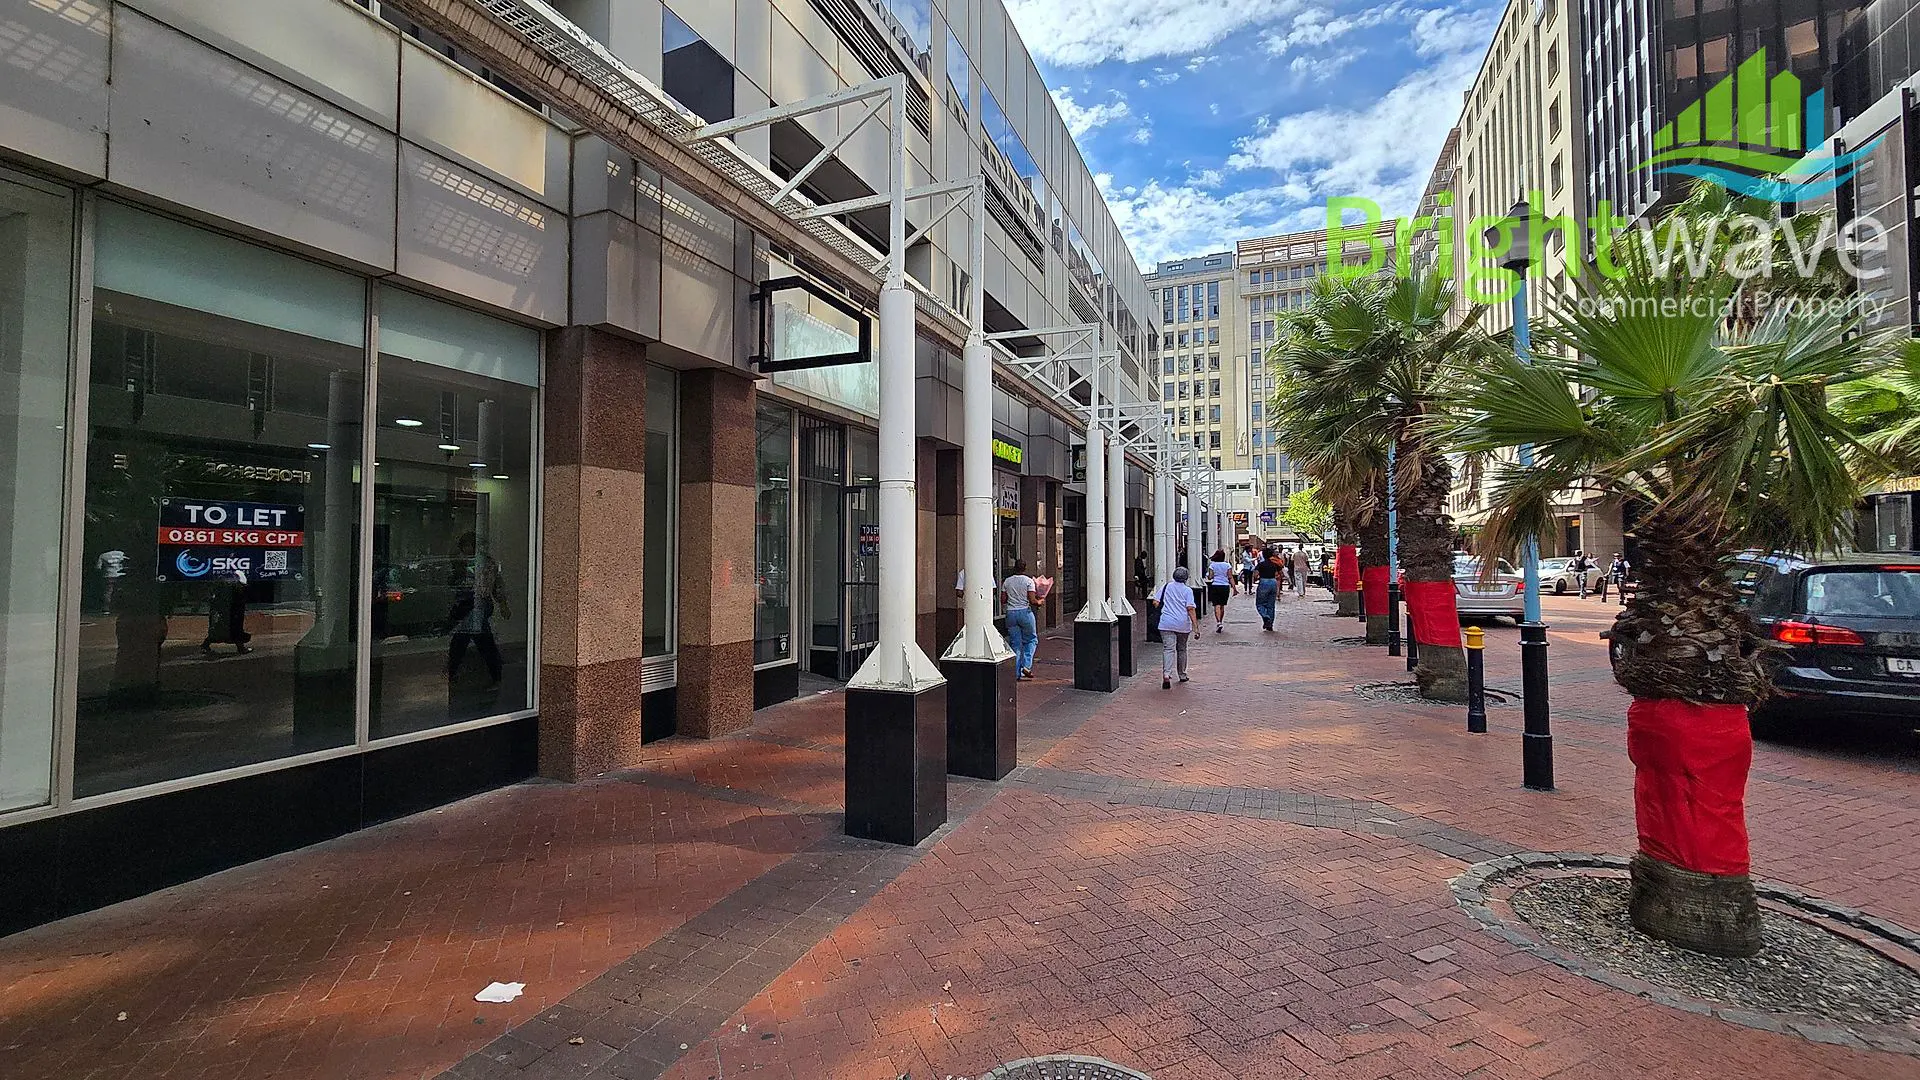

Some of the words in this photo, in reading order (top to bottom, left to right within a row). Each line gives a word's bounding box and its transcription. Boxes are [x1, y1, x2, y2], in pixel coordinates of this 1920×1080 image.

[184, 505, 227, 524] TO
[237, 507, 287, 526] LET
[169, 530, 215, 542] 0861
[222, 531, 259, 543] SKG
[265, 533, 298, 544] CPT
[212, 557, 250, 570] SKG
[1896, 660, 1914, 671] CA
